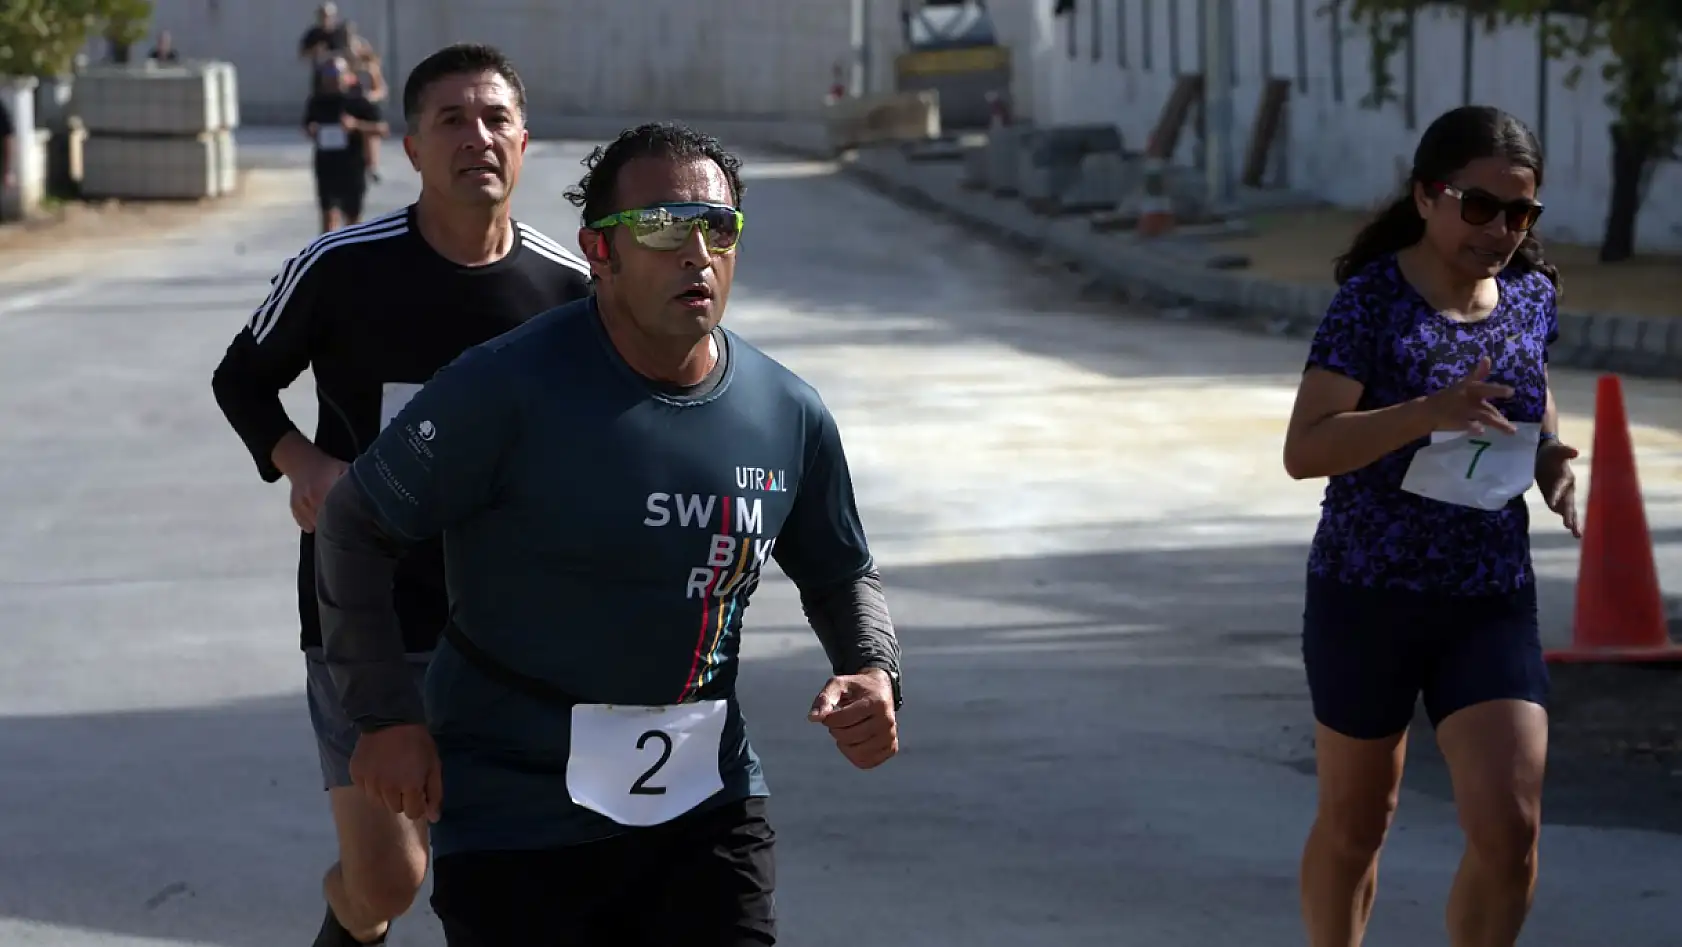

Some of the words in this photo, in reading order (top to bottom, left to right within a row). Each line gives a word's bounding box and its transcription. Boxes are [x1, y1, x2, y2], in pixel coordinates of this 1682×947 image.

[735, 466, 786, 492] UTRAIL
[1465, 439, 1492, 479] 7
[643, 492, 762, 534] SWIM
[707, 533, 776, 570] BIK
[629, 729, 672, 795] 2
